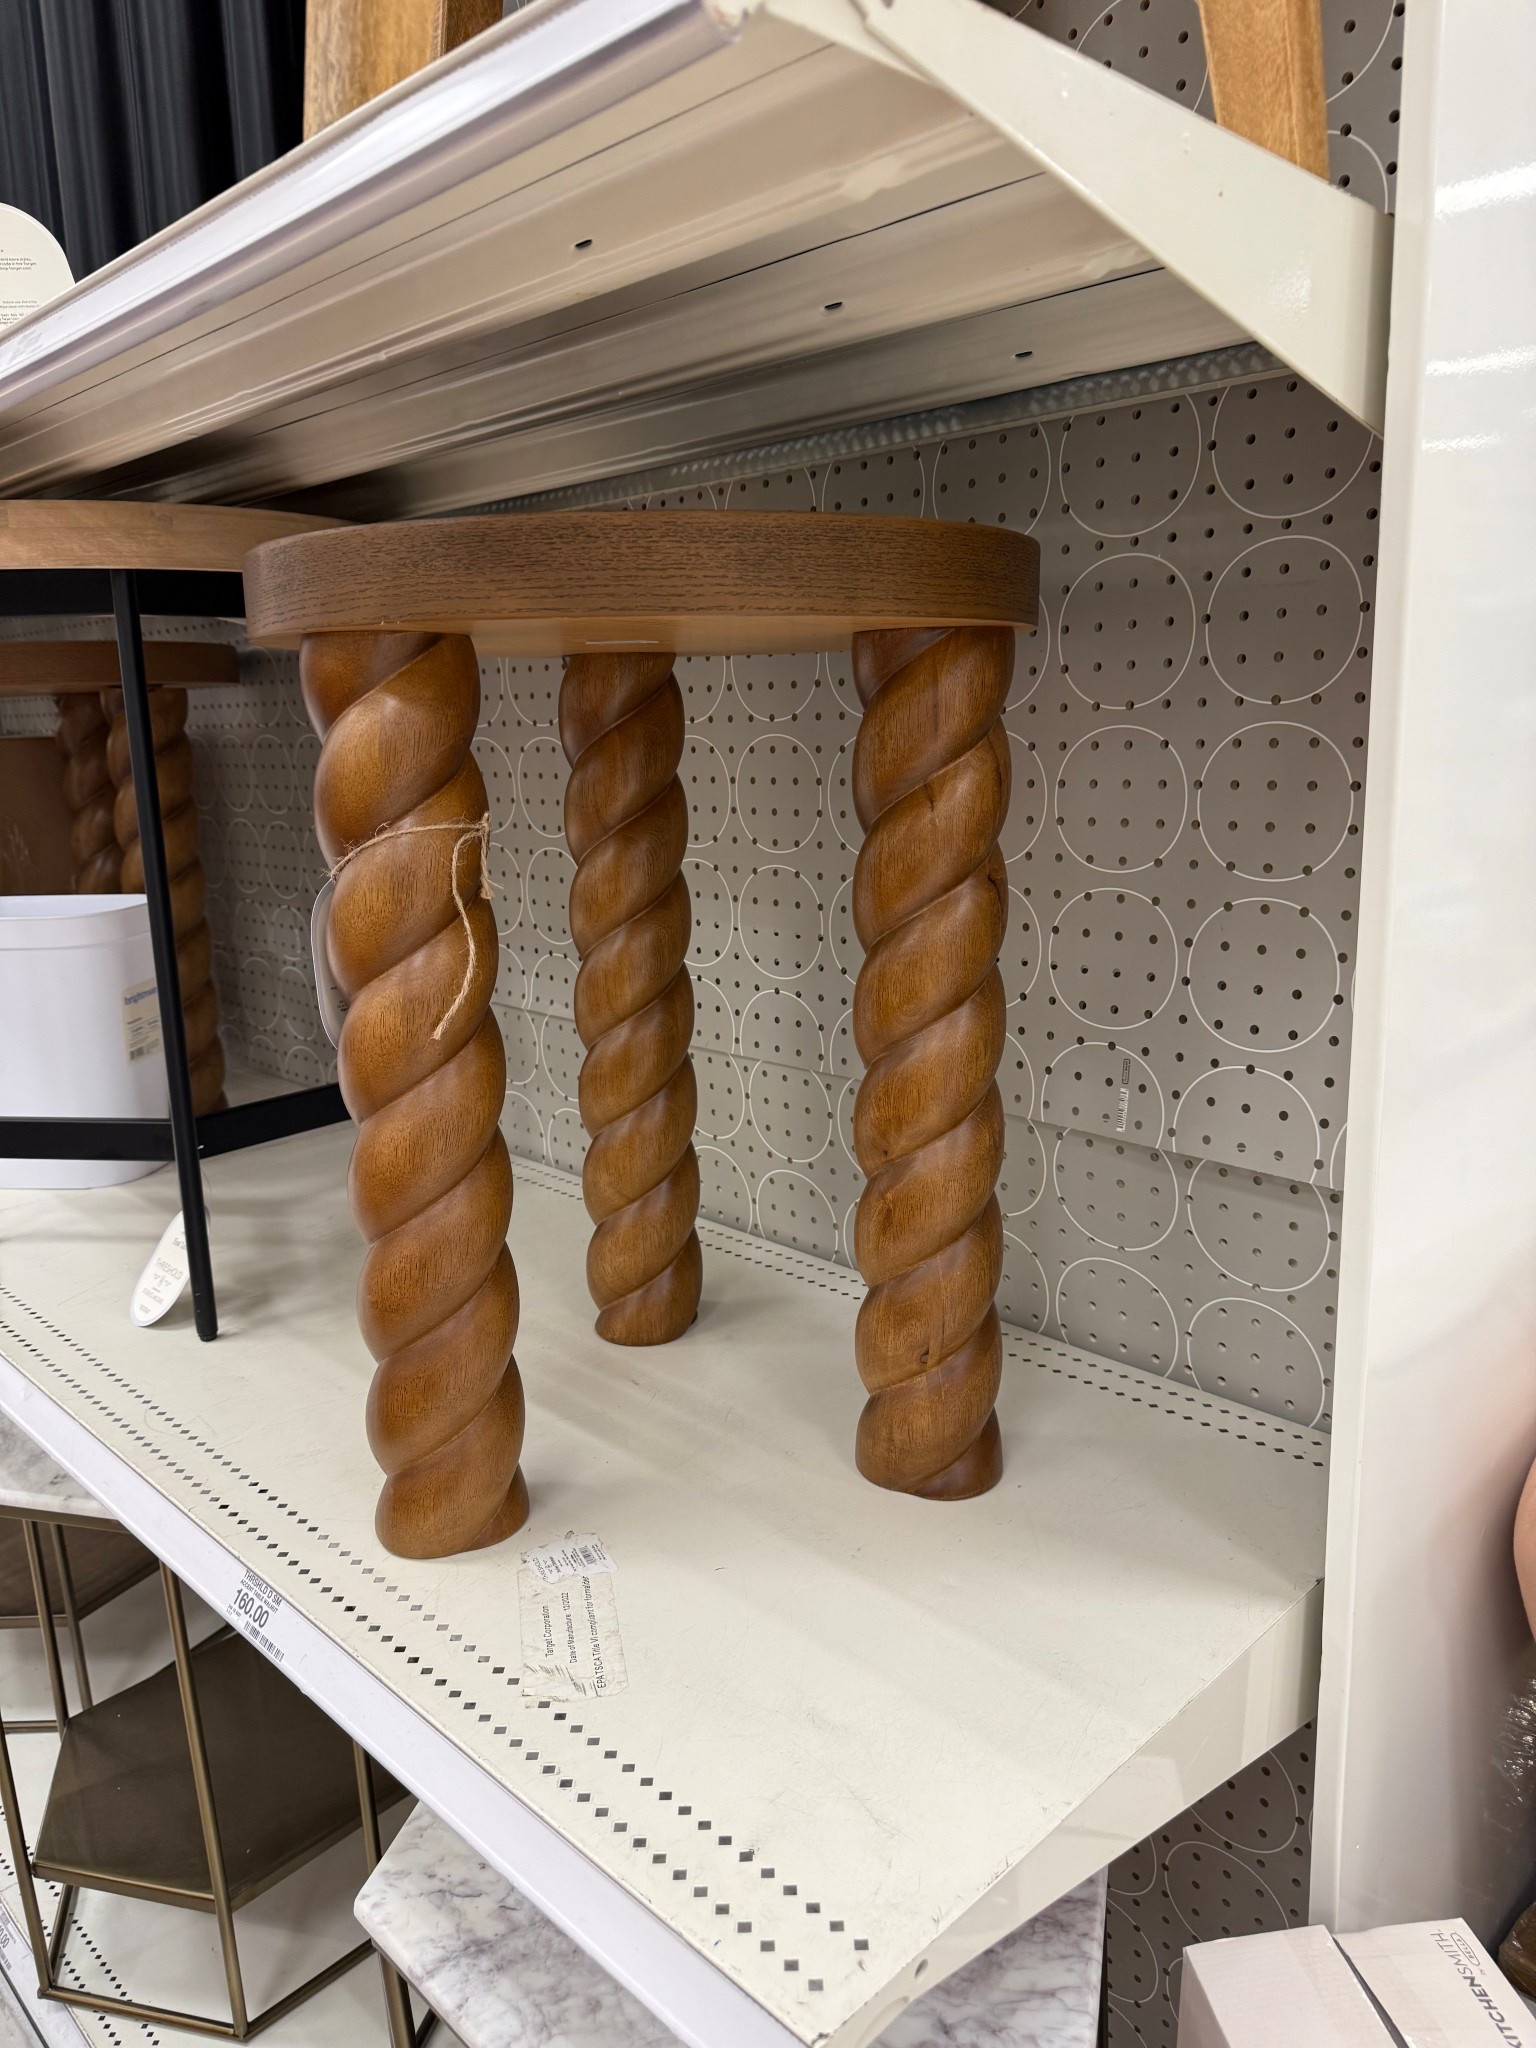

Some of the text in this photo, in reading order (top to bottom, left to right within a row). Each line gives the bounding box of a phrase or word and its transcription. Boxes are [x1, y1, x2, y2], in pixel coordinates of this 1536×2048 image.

[233, 1588, 269, 1628] 160.00
[272, 1594, 283, 1607] SM
[585, 1601, 594, 1609] for
[542, 1604, 555, 1658] Target Corporation
[569, 1650, 577, 1663] Date
[593, 1656, 604, 1675] TSCA
[596, 1674, 607, 1689] EPA
